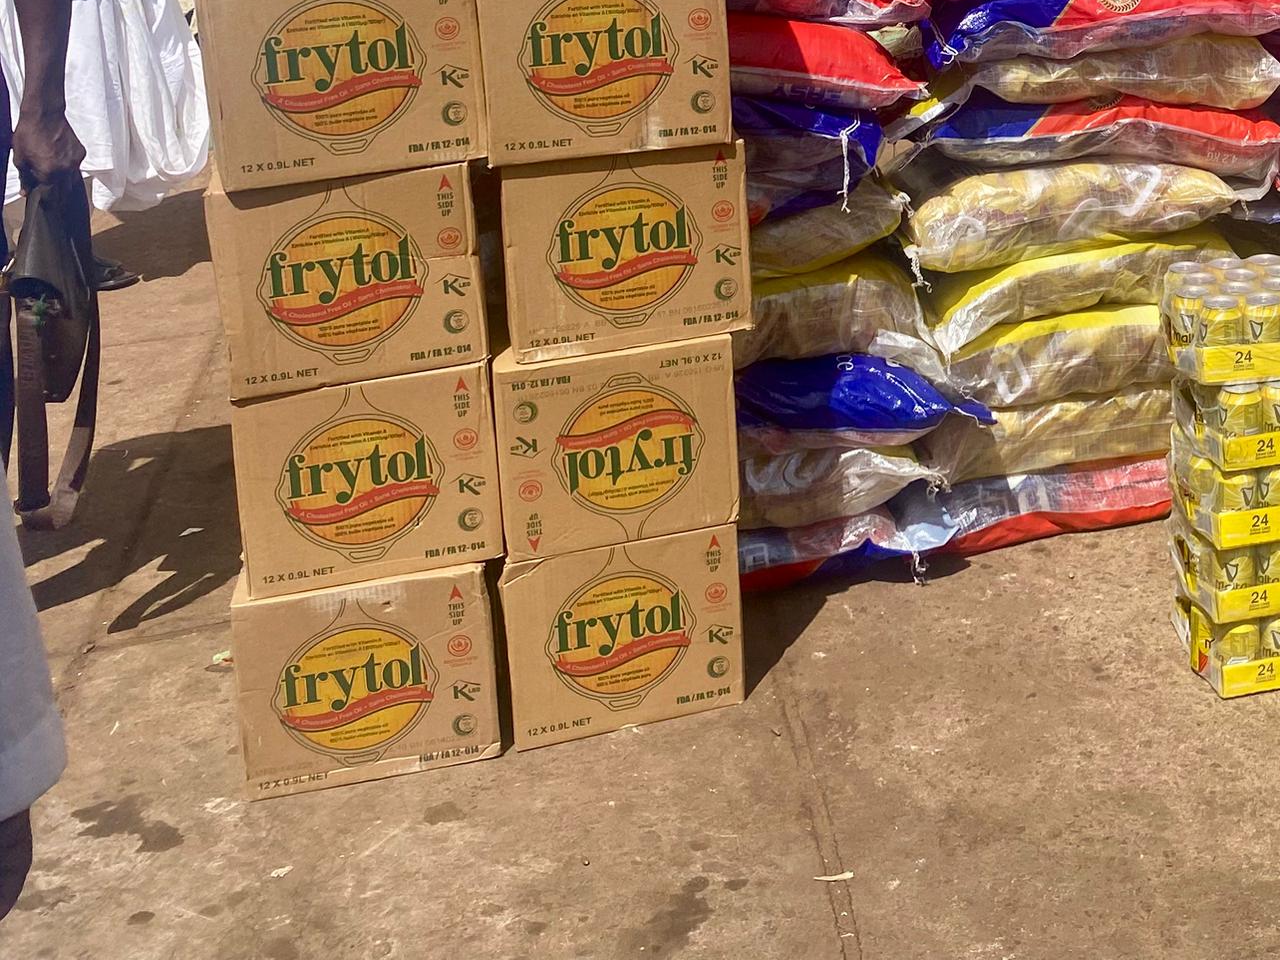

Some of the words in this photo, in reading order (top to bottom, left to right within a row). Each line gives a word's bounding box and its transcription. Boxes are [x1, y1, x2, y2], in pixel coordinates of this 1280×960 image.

[528, 16, 666, 75] frytol
[261, 25, 413, 91] frytol
[658, 129, 673, 138] FDA
[680, 127, 688, 136] FA
[409, 144, 424, 153] FDA
[431, 142, 441, 151] FA
[505, 143, 516, 151] 12
[518, 142, 526, 150] X
[528, 141, 550, 150] 0.9L
[552, 139, 573, 148] NET
[241, 165, 254, 174] 12
[256, 163, 265, 172] X
[268, 161, 290, 171] 0.9L
[293, 158, 316, 168] NET
[437, 193, 454, 201] THIS
[437, 201, 453, 209] SIDE
[441, 209, 451, 217] UP
[556, 208, 691, 269] frytol
[267, 238, 415, 304] frytol
[553, 337, 573, 345] 0.9L
[576, 333, 596, 343] NET
[410, 352, 425, 361] FDA
[433, 349, 442, 358] FA
[681, 356, 700, 365] 0.9L
[712, 352, 722, 360] 12
[1235, 350, 1253, 364] 24
[659, 359, 678, 368] NET
[245, 377, 257, 385] 12
[260, 375, 268, 383] X
[271, 372, 293, 382] 0.9L
[297, 368, 319, 378] NET
[1257, 438, 1274, 452] 24
[564, 429, 696, 494] frytol
[285, 436, 433, 503] frytol
[526, 521, 542, 529] SIDE
[1252, 514, 1269, 528] 24
[527, 529, 543, 537] THIS
[425, 550, 440, 558] FDA
[447, 548, 456, 556] FA
[263, 575, 275, 584] 12
[277, 574, 285, 582] X
[288, 571, 310, 580] 0.9L
[313, 567, 335, 576] NET
[1251, 590, 1268, 603] 24
[448, 603, 465, 611] THIS
[555, 592, 685, 655] frytol
[1257, 662, 1274, 676] 24
[281, 645, 426, 711] frytol
[550, 722, 570, 733] 0.9L
[572, 717, 592, 727] NET
[258, 781, 271, 790] 12
[273, 779, 281, 787] X
[284, 775, 306, 786] 0.9L
[308, 772, 329, 782] NET
